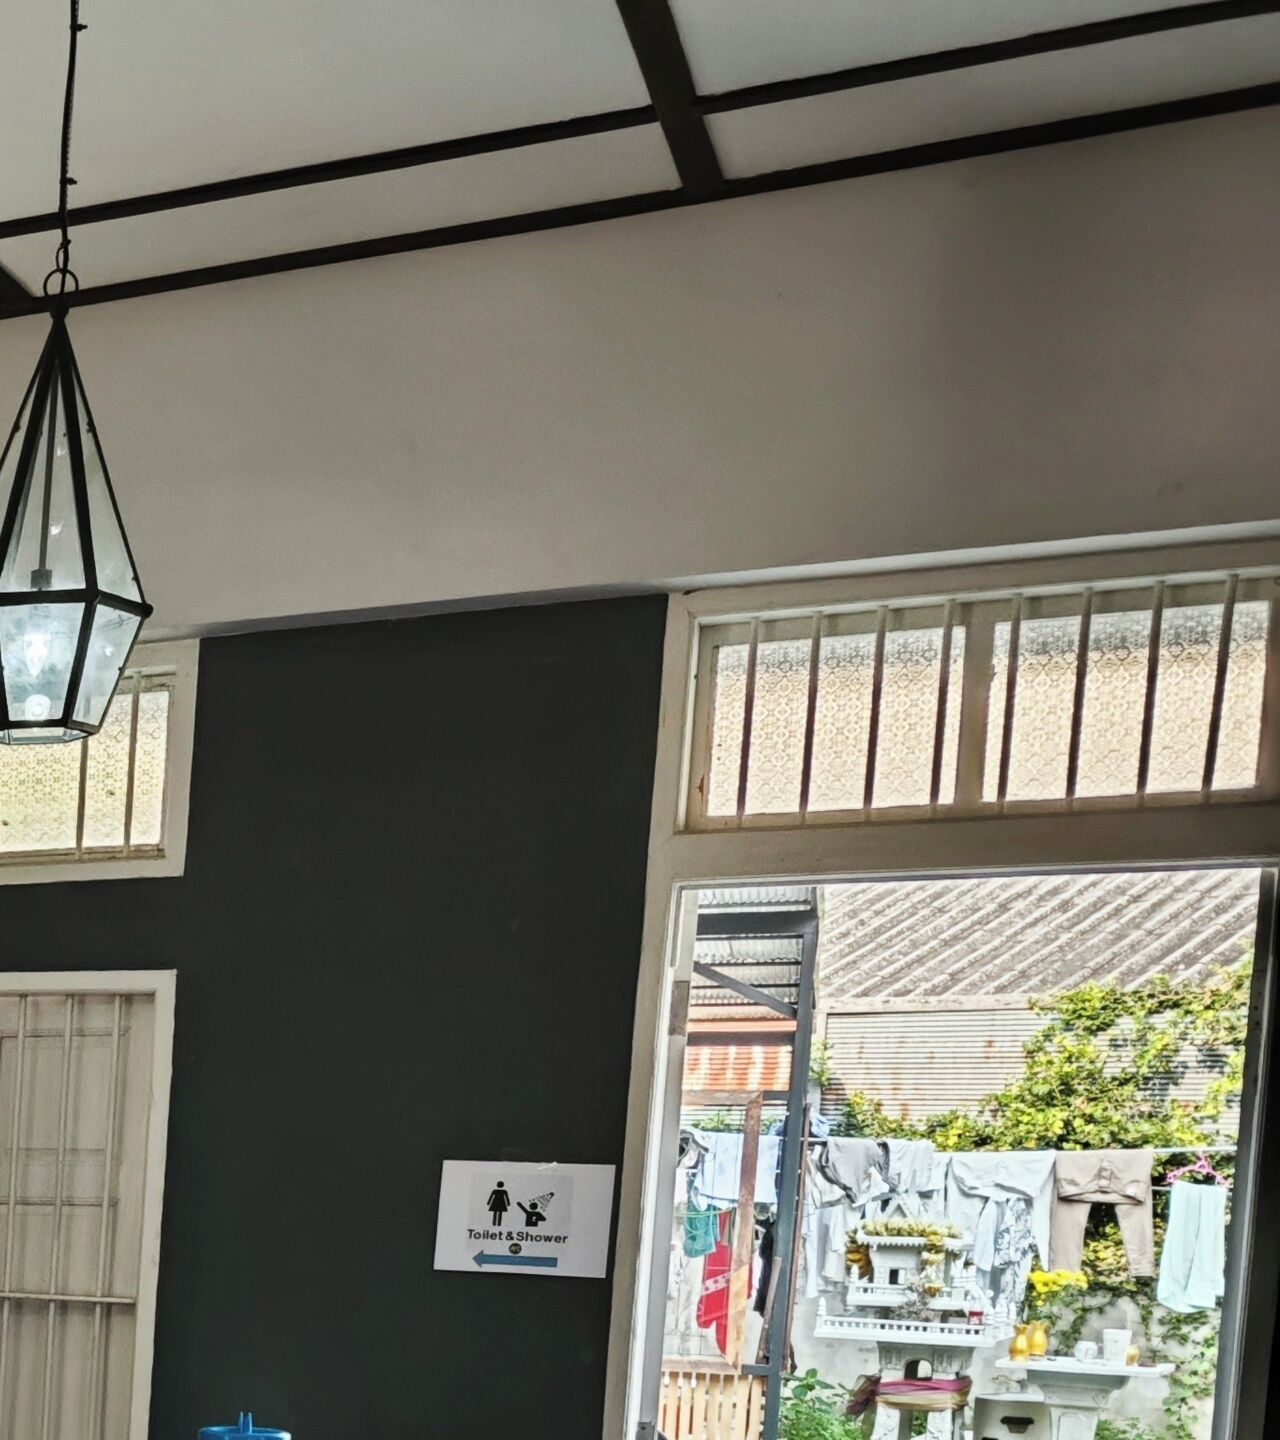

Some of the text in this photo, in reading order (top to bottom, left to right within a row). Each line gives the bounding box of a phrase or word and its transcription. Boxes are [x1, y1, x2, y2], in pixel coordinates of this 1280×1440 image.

[467, 1229, 568, 1243] Toilet & Shower
